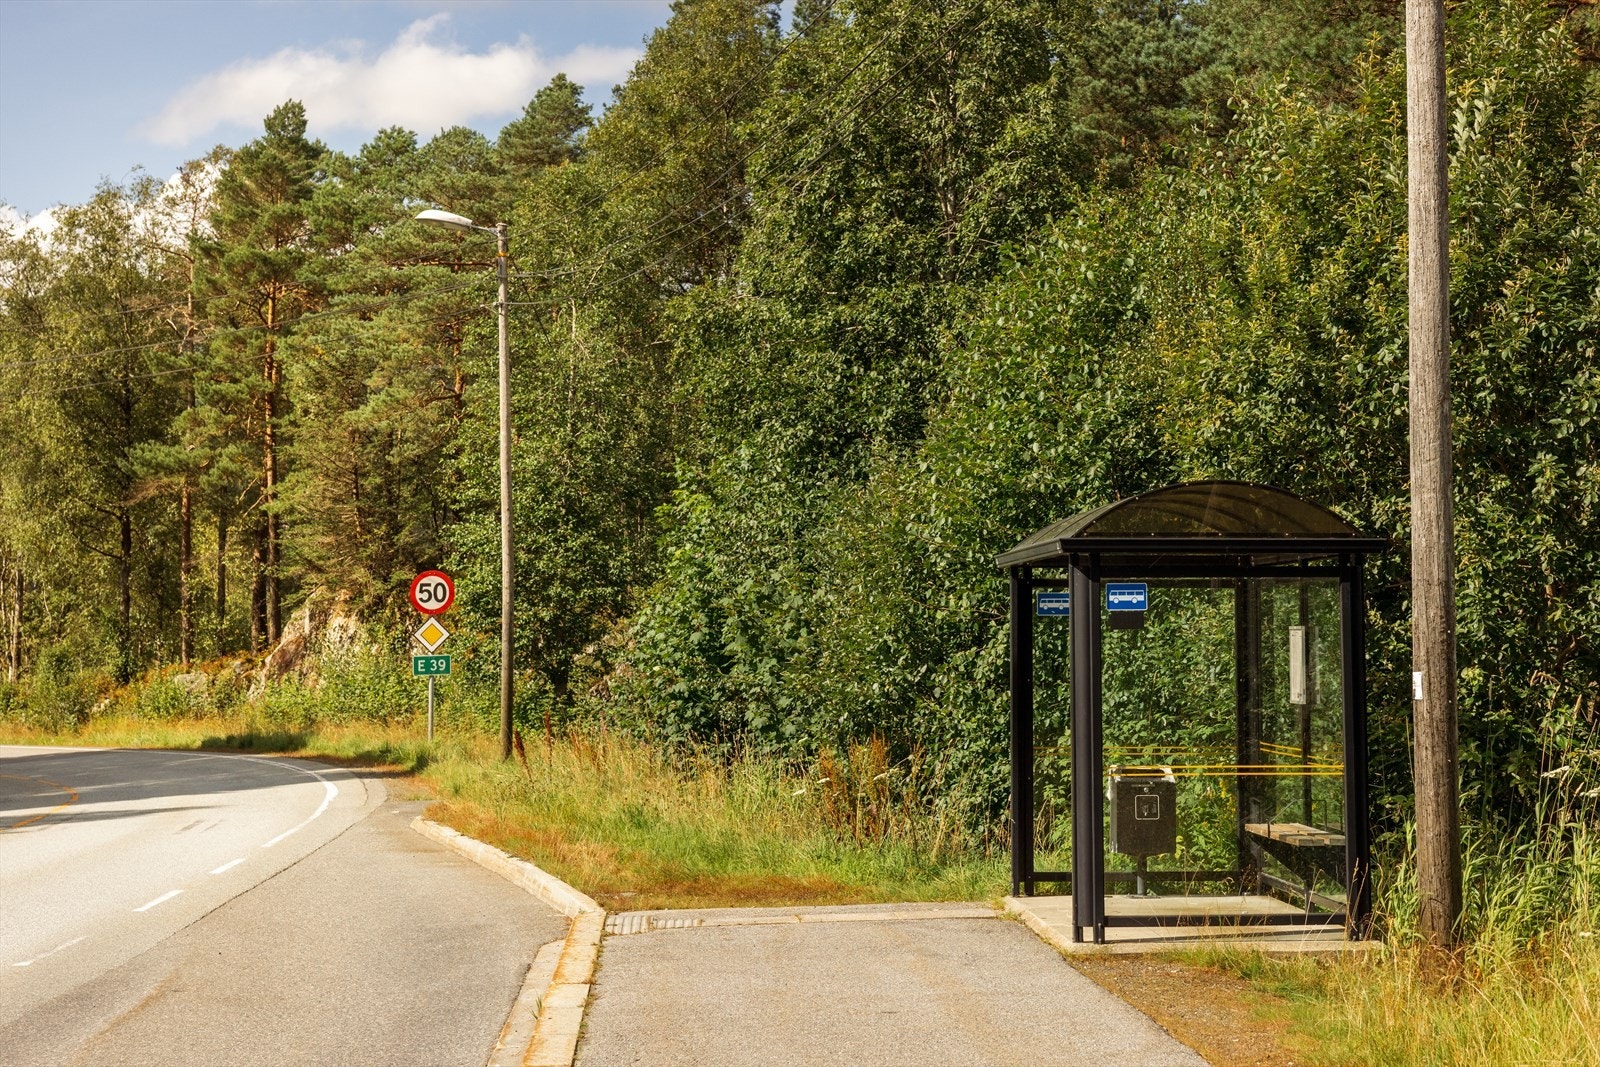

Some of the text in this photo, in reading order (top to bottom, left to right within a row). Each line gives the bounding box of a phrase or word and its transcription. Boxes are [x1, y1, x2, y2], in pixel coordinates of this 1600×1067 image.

[419, 582, 447, 603] 50
[418, 659, 446, 671] E 39
